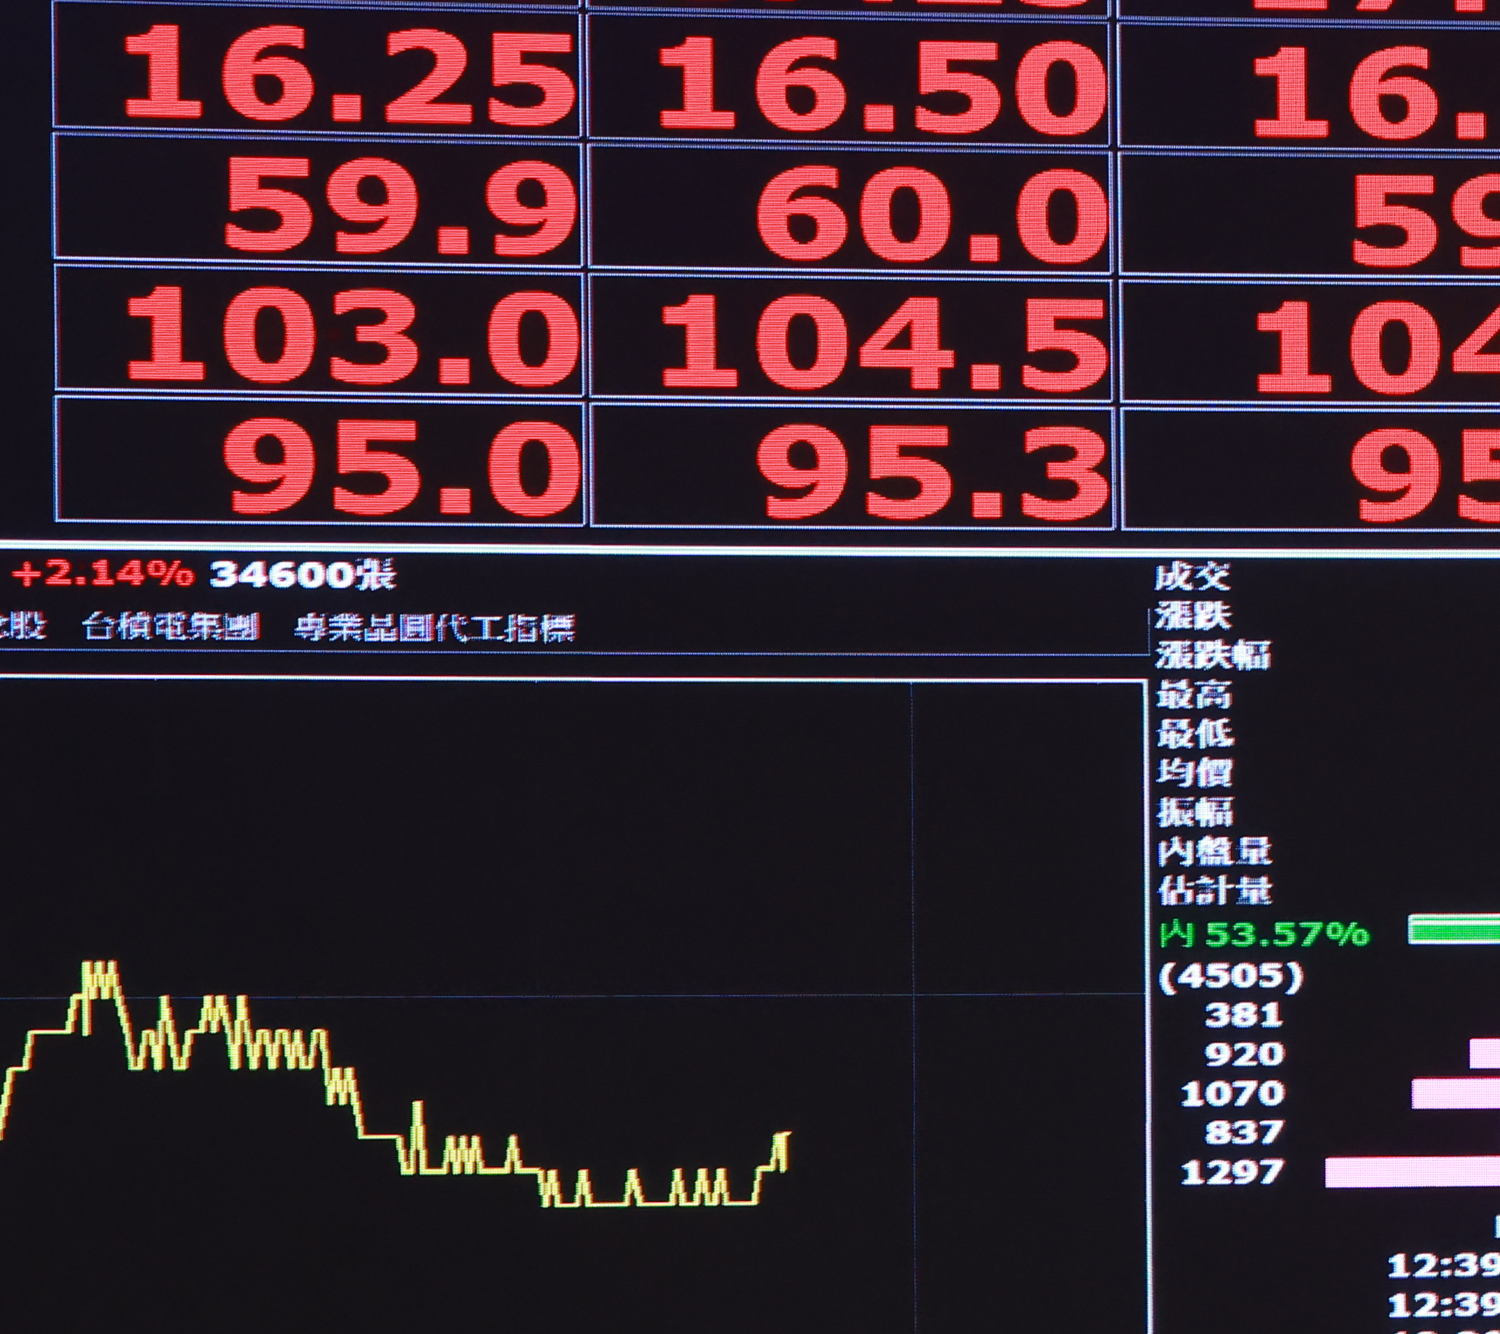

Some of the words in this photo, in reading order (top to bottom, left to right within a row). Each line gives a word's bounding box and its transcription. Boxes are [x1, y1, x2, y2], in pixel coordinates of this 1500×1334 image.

[223, 417, 581, 517] 95.0
[756, 423, 1110, 522] 95.3
[12, 559, 196, 587] +2.14%
[210, 558, 396, 591] 34600張
[1155, 561, 1230, 590] 成交
[1155, 601, 1231, 630] 漲跌
[1155, 639, 1271, 670] 漲跌幅
[1157, 679, 1232, 709] 最高
[1158, 718, 1234, 749] 最低
[1156, 757, 1232, 787] 均價
[1156, 797, 1233, 827] 振幅
[1159, 875, 1272, 905] 估計量
[1206, 922, 1370, 947] 53.57%
[1159, 962, 1303, 995] (4505)
[1206, 1002, 1283, 1028] 381
[1205, 1042, 1284, 1066] 920
[1182, 1080, 1284, 1106] 1070
[1205, 1120, 1283, 1144] 837
[1182, 1159, 1284, 1185] 1297
